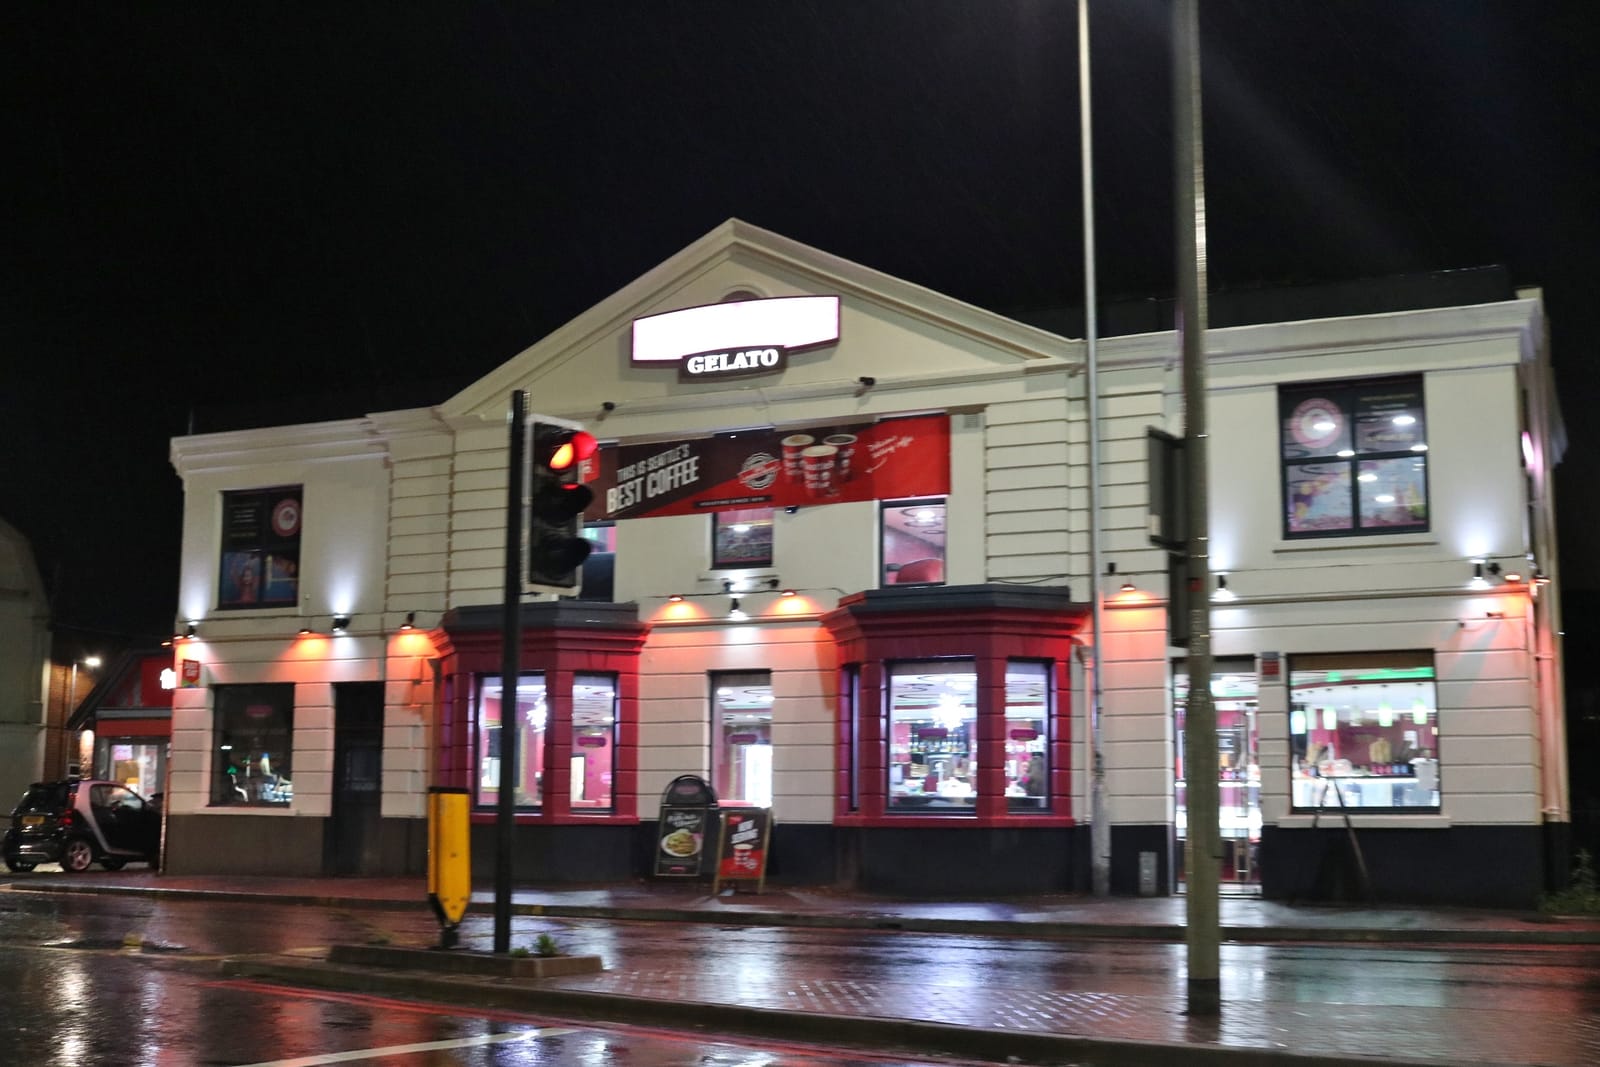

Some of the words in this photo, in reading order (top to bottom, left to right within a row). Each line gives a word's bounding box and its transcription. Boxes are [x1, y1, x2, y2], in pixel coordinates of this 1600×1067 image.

[687, 349, 779, 374] GELATO
[617, 464, 636, 482] THIS
[637, 460, 646, 474] IS
[647, 443, 690, 471] SEATTLE'S
[606, 477, 645, 514] BEST
[646, 456, 700, 498] COFFEE
